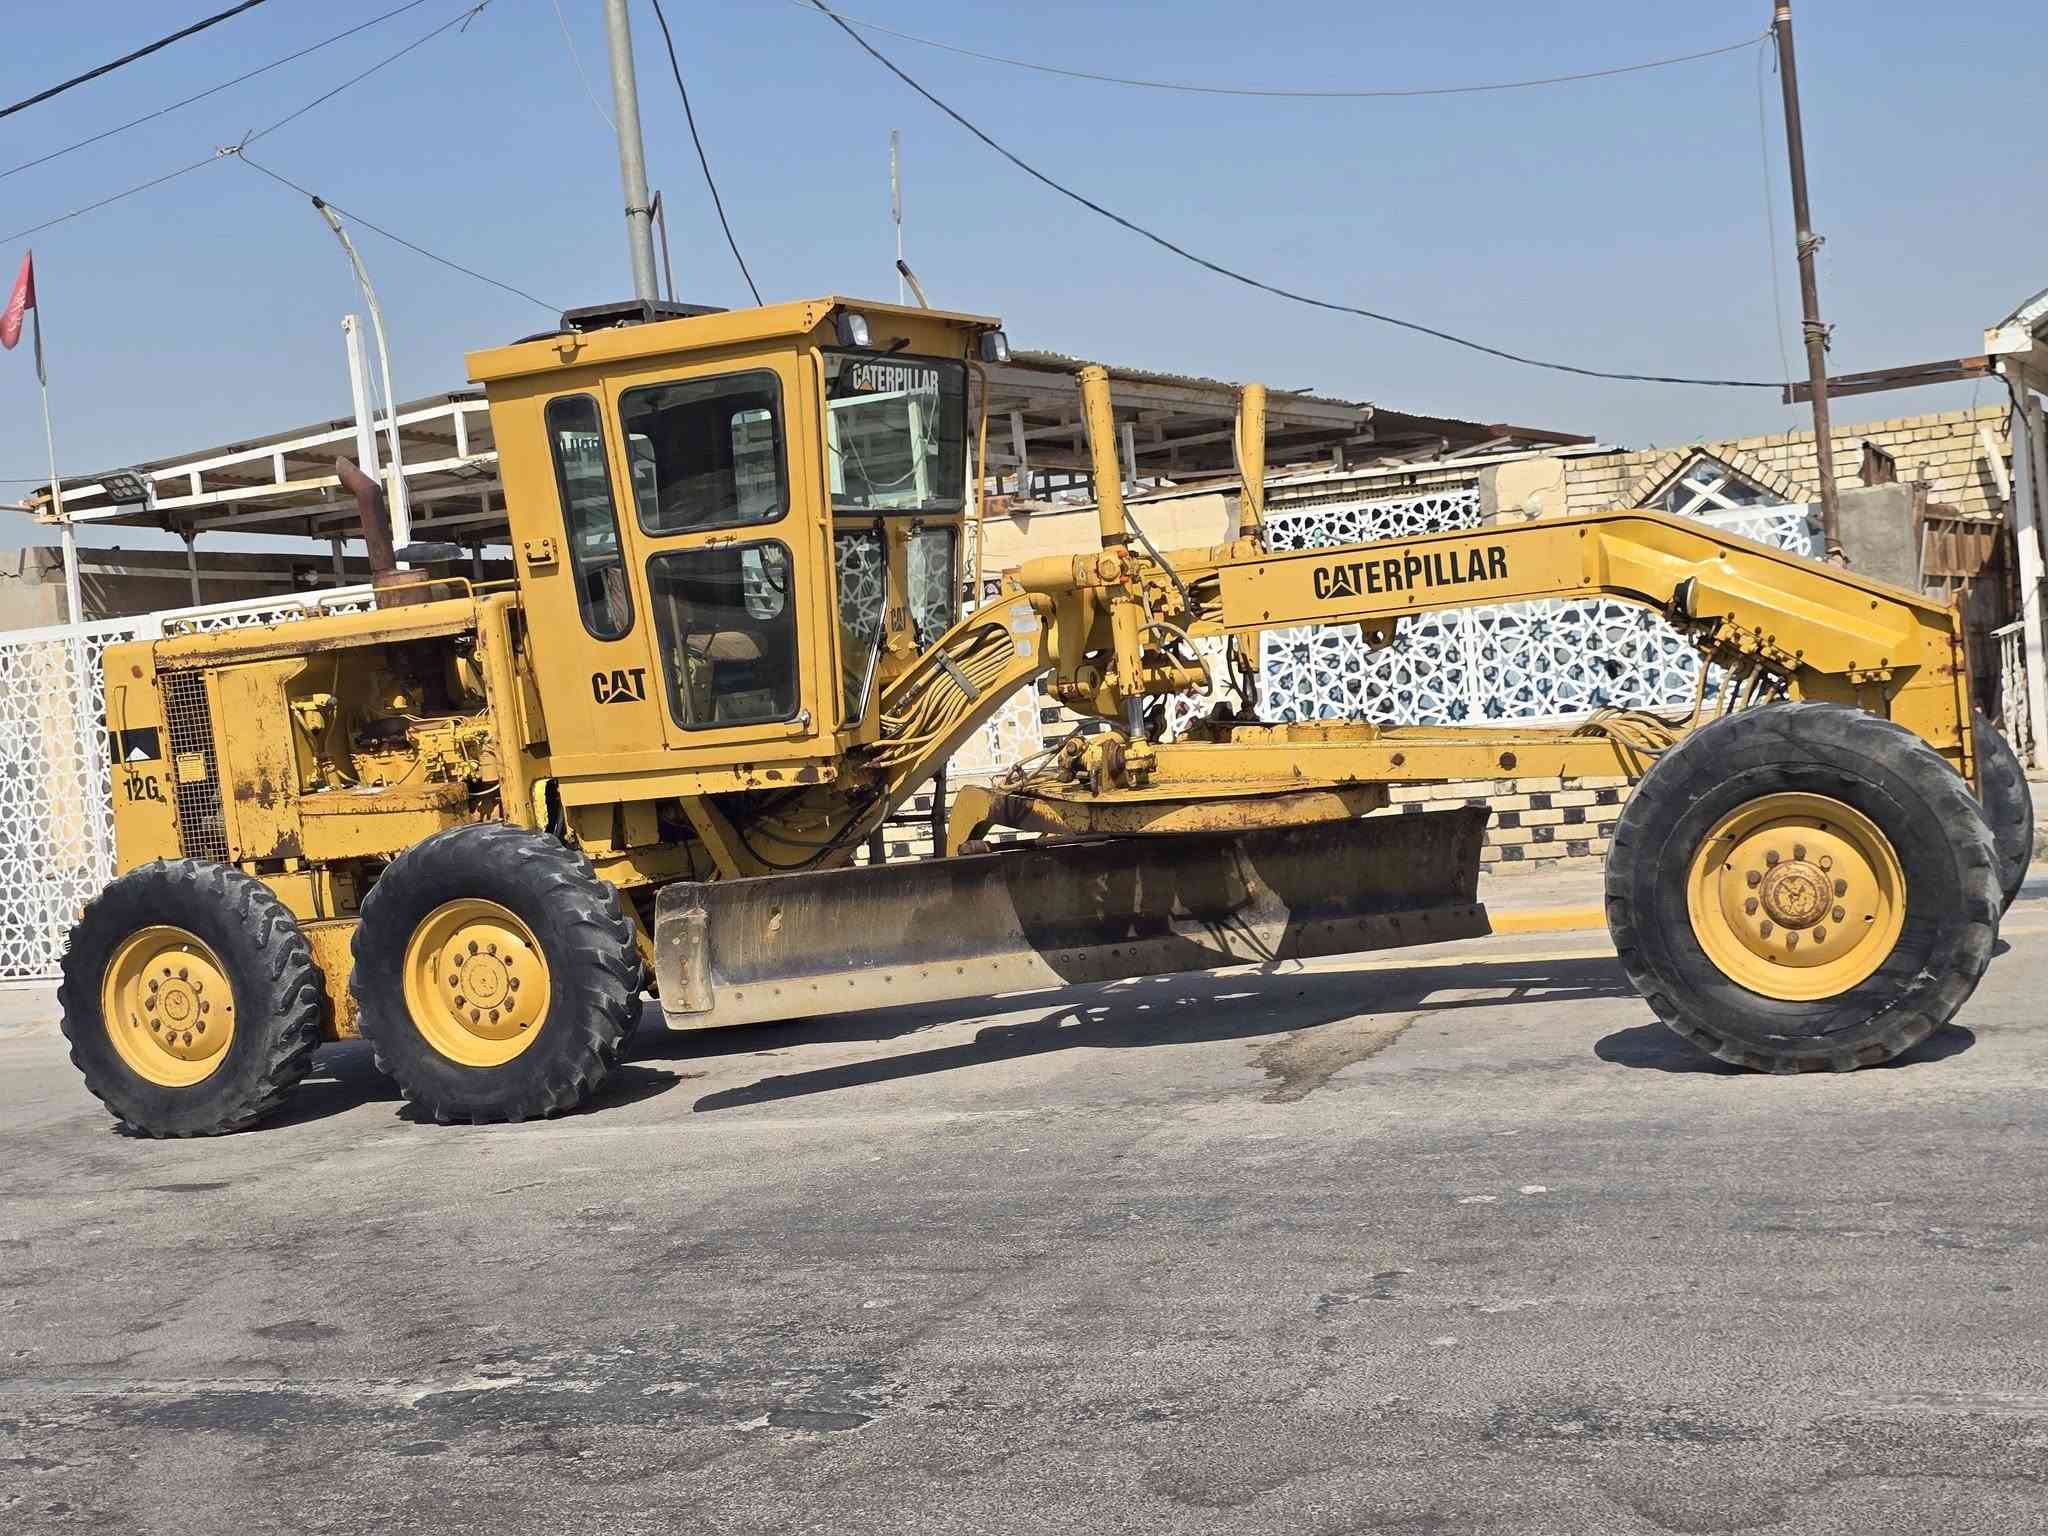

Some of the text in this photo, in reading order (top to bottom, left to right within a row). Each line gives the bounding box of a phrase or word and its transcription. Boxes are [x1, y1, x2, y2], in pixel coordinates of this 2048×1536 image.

[852, 363, 939, 395] CATERPILLAR
[1313, 546, 1508, 600] CATERPILLAR
[592, 668, 646, 704] CAT
[123, 776, 160, 801] 12G
